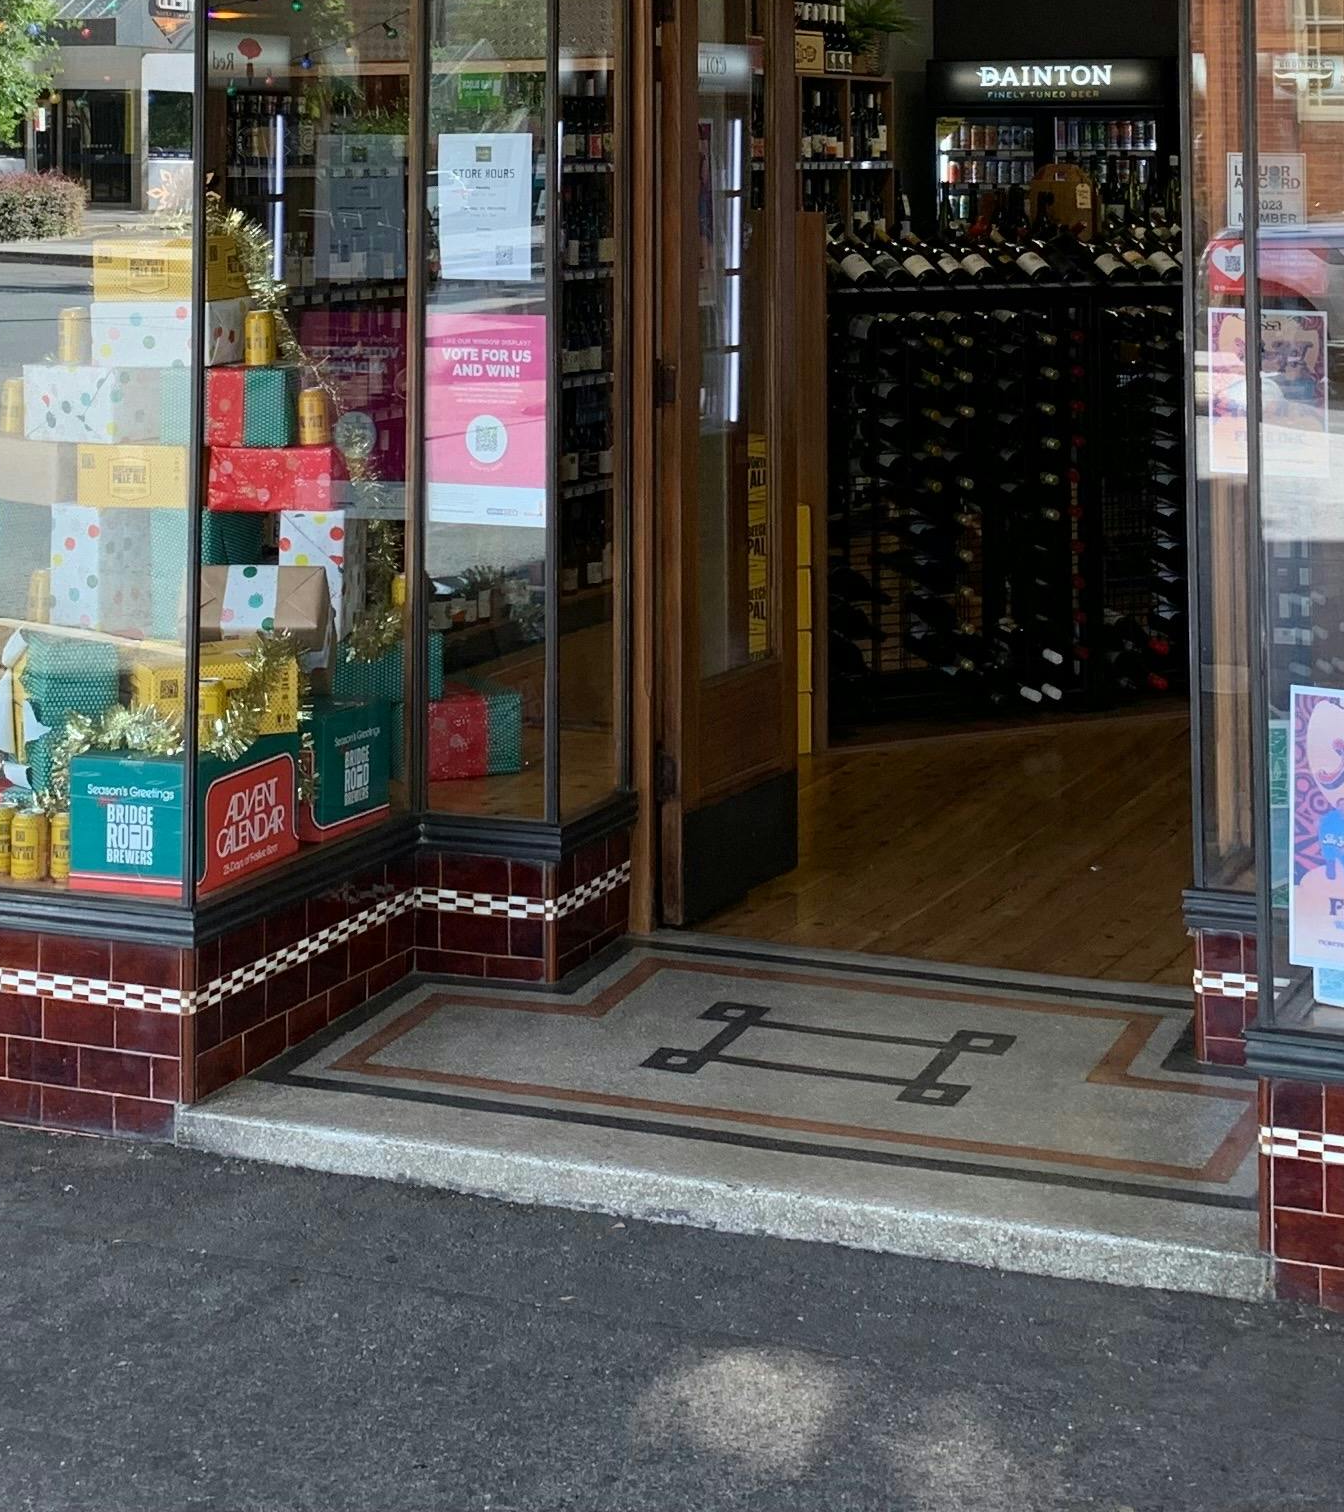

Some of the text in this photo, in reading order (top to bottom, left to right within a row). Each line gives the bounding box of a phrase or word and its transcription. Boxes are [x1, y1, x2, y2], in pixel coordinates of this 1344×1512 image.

[975, 64, 1113, 87] DAINTON
[987, 89, 1100, 99] FINELY TUNED BEER
[452, 168, 516, 179] STORE HOURS
[1234, 165, 1291, 177] LUOR
[1238, 213, 1297, 224] MMBER
[441, 347, 532, 363] VOTE FOR US
[452, 363, 521, 378] AND WIN!
[344, 744, 370, 769] BRIDGE
[87, 783, 175, 802] Season's Greetings
[224, 777, 279, 826] ADVENT
[107, 803, 154, 826] BRIDGE
[216, 806, 285, 859] CALENDAR
[106, 850, 153, 866] BREWERS
